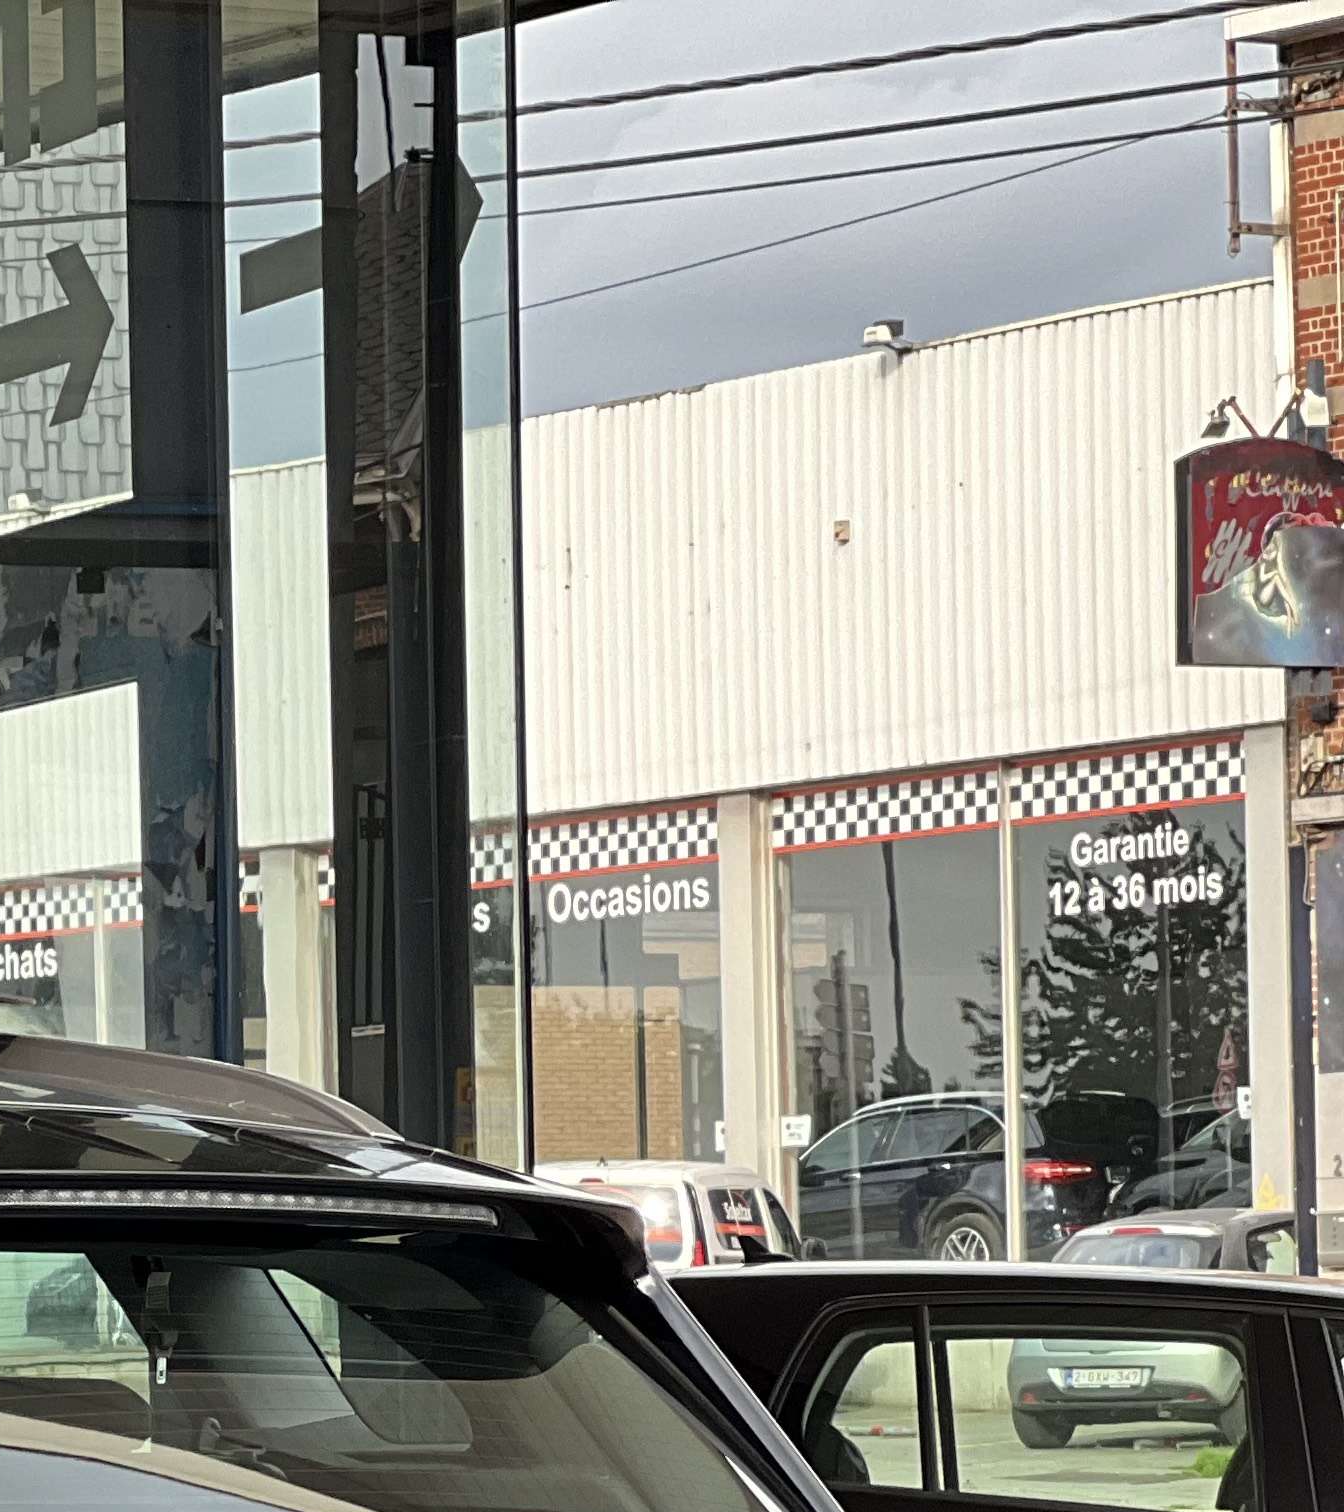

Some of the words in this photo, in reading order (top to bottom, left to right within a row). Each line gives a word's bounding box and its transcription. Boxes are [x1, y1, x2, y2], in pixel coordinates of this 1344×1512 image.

[1070, 821, 1190, 867] Garantie
[547, 873, 710, 923] Occasions
[1049, 880, 1083, 917] 12
[1088, 875, 1107, 912] à
[1111, 874, 1146, 908] 36
[1152, 865, 1224, 905] mois
